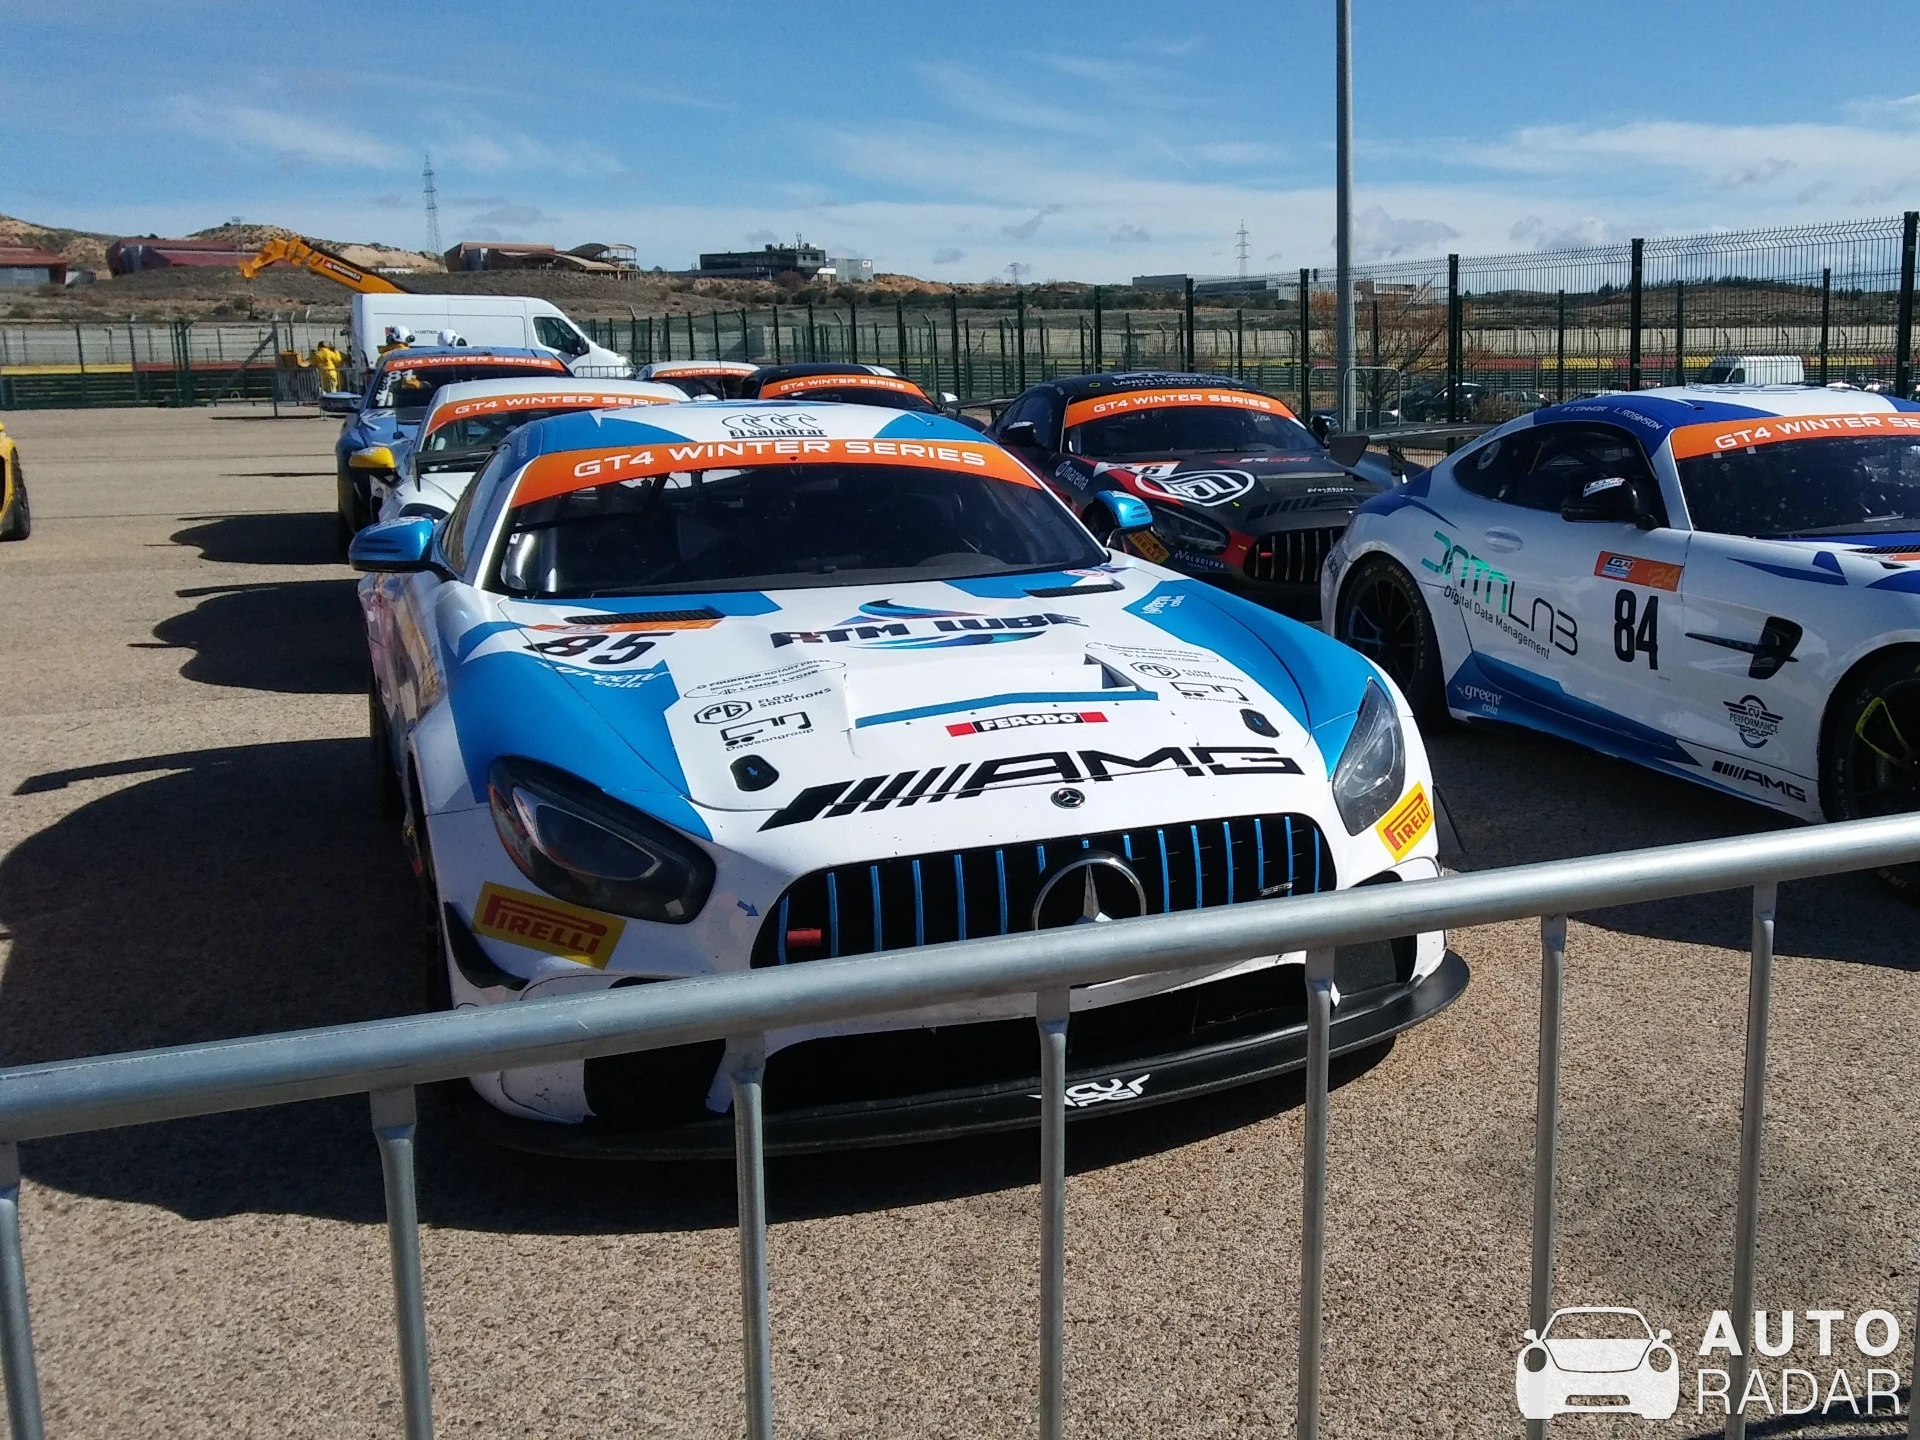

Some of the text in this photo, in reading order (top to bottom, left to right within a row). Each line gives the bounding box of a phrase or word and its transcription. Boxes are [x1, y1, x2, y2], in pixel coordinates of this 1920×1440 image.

[394, 355, 551, 368] GT4 WINTER SERIES
[780, 377, 905, 391] GT4 WINTER SERIES
[455, 400, 498, 414] GT4
[504, 395, 595, 406] WINTER
[1093, 394, 1271, 413] GT4 WINTER SERIES
[1714, 426, 1772, 449] GT4
[1775, 415, 1884, 435] WINTER
[573, 439, 986, 478] GT4 WINTER SERIES
[1443, 584, 1551, 660] Digital Data Management
[1614, 588, 1659, 671] 84
[522, 631, 676, 665] 85
[757, 692, 794, 704] FLOW
[759, 687, 832, 708] SOLUTIONS
[1463, 685, 1502, 706] green
[1482, 702, 1499, 716] cola
[979, 713, 1078, 731] FERODO
[1729, 712, 1779, 734] PERFORMANCE
[725, 727, 815, 752] Dawsongroup
[958, 746, 1305, 799] AMG
[1742, 771, 1807, 803] AMG
[1383, 791, 1430, 852] PIRELLI
[481, 893, 608, 956] PIRELLI
